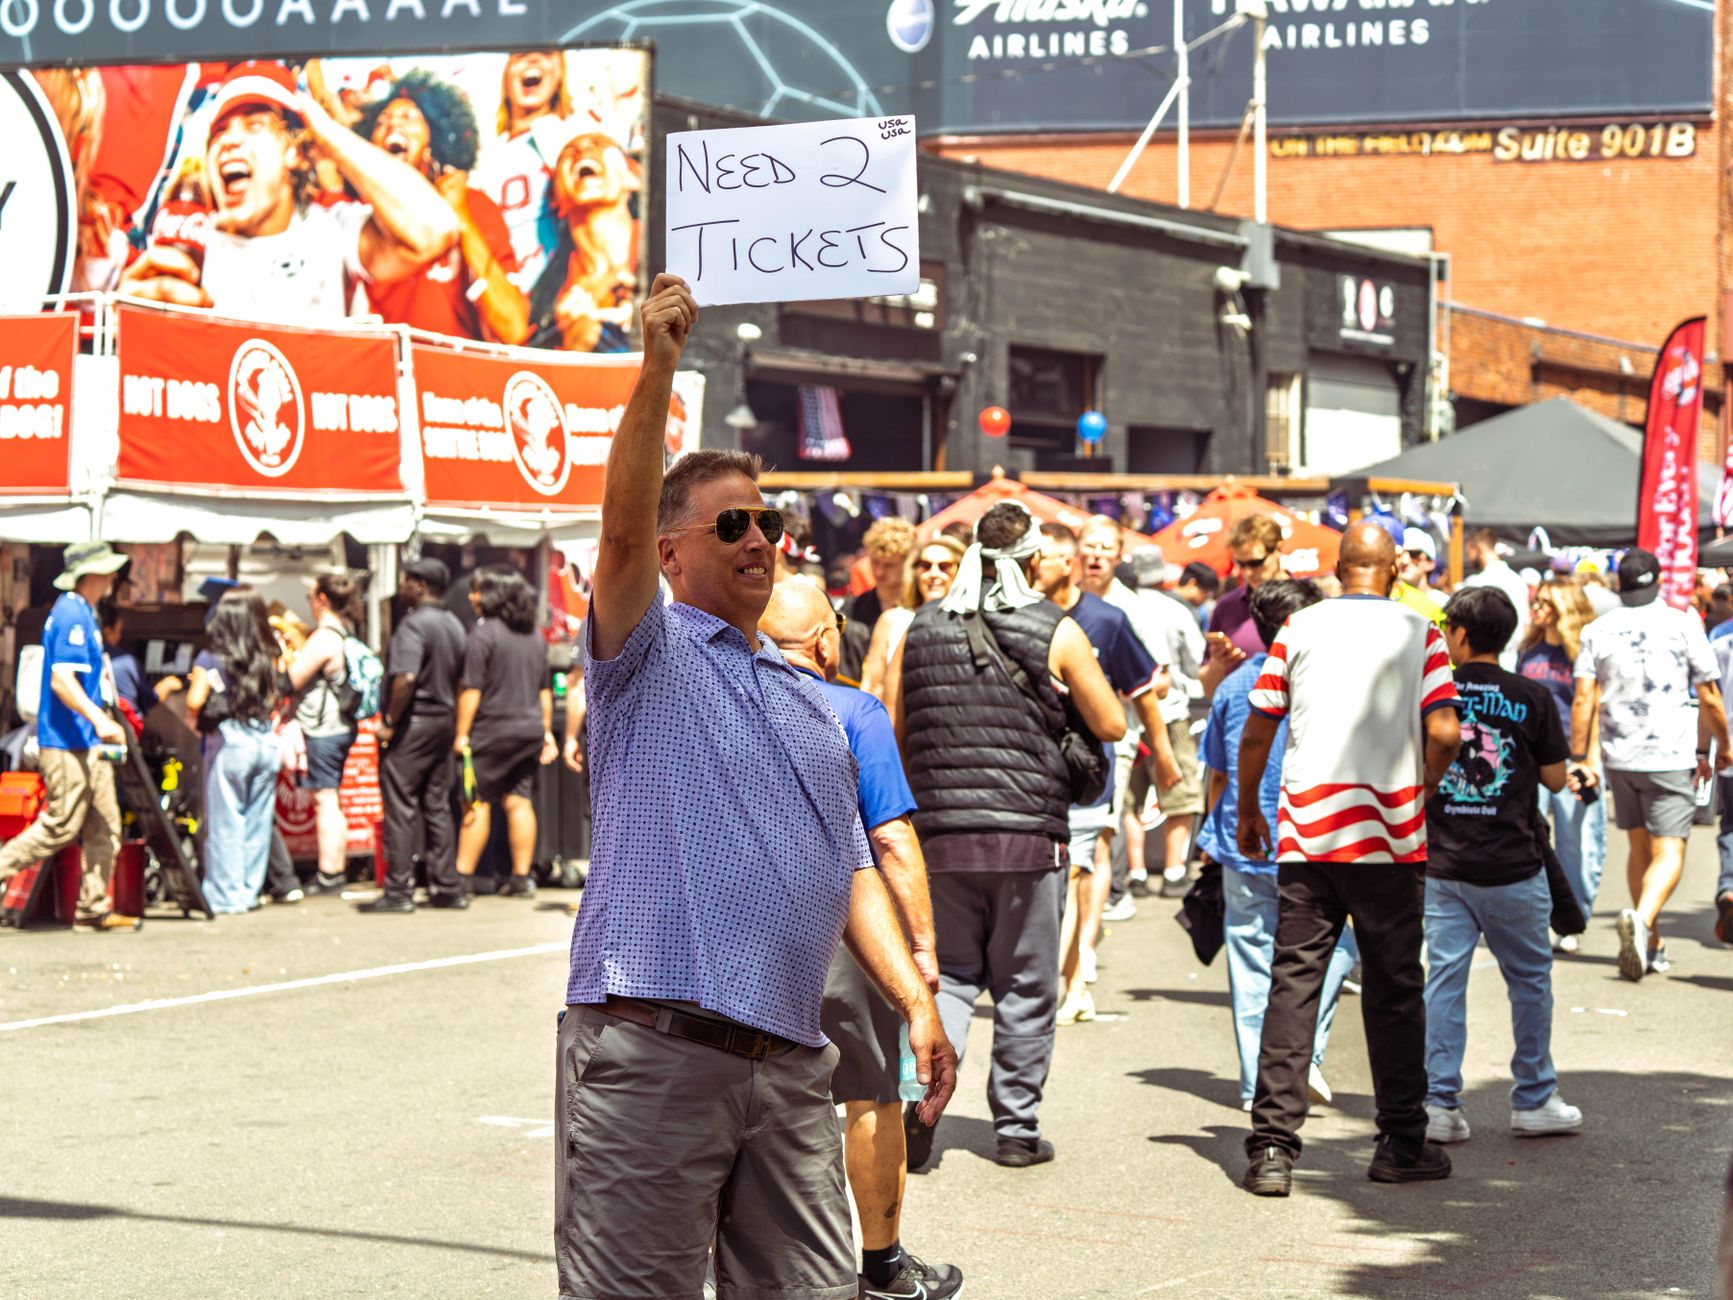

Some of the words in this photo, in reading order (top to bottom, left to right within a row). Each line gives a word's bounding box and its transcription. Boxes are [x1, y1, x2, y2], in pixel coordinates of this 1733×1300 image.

[968, 29, 1129, 59] AIRLINES
[1259, 18, 1430, 50] AIRLINES
[1494, 126, 1591, 161] Suite
[1601, 122, 1696, 158] 901B
[677, 140, 796, 194] NEED
[820, 136, 887, 194] 2
[671, 218, 910, 282] TICKETS
